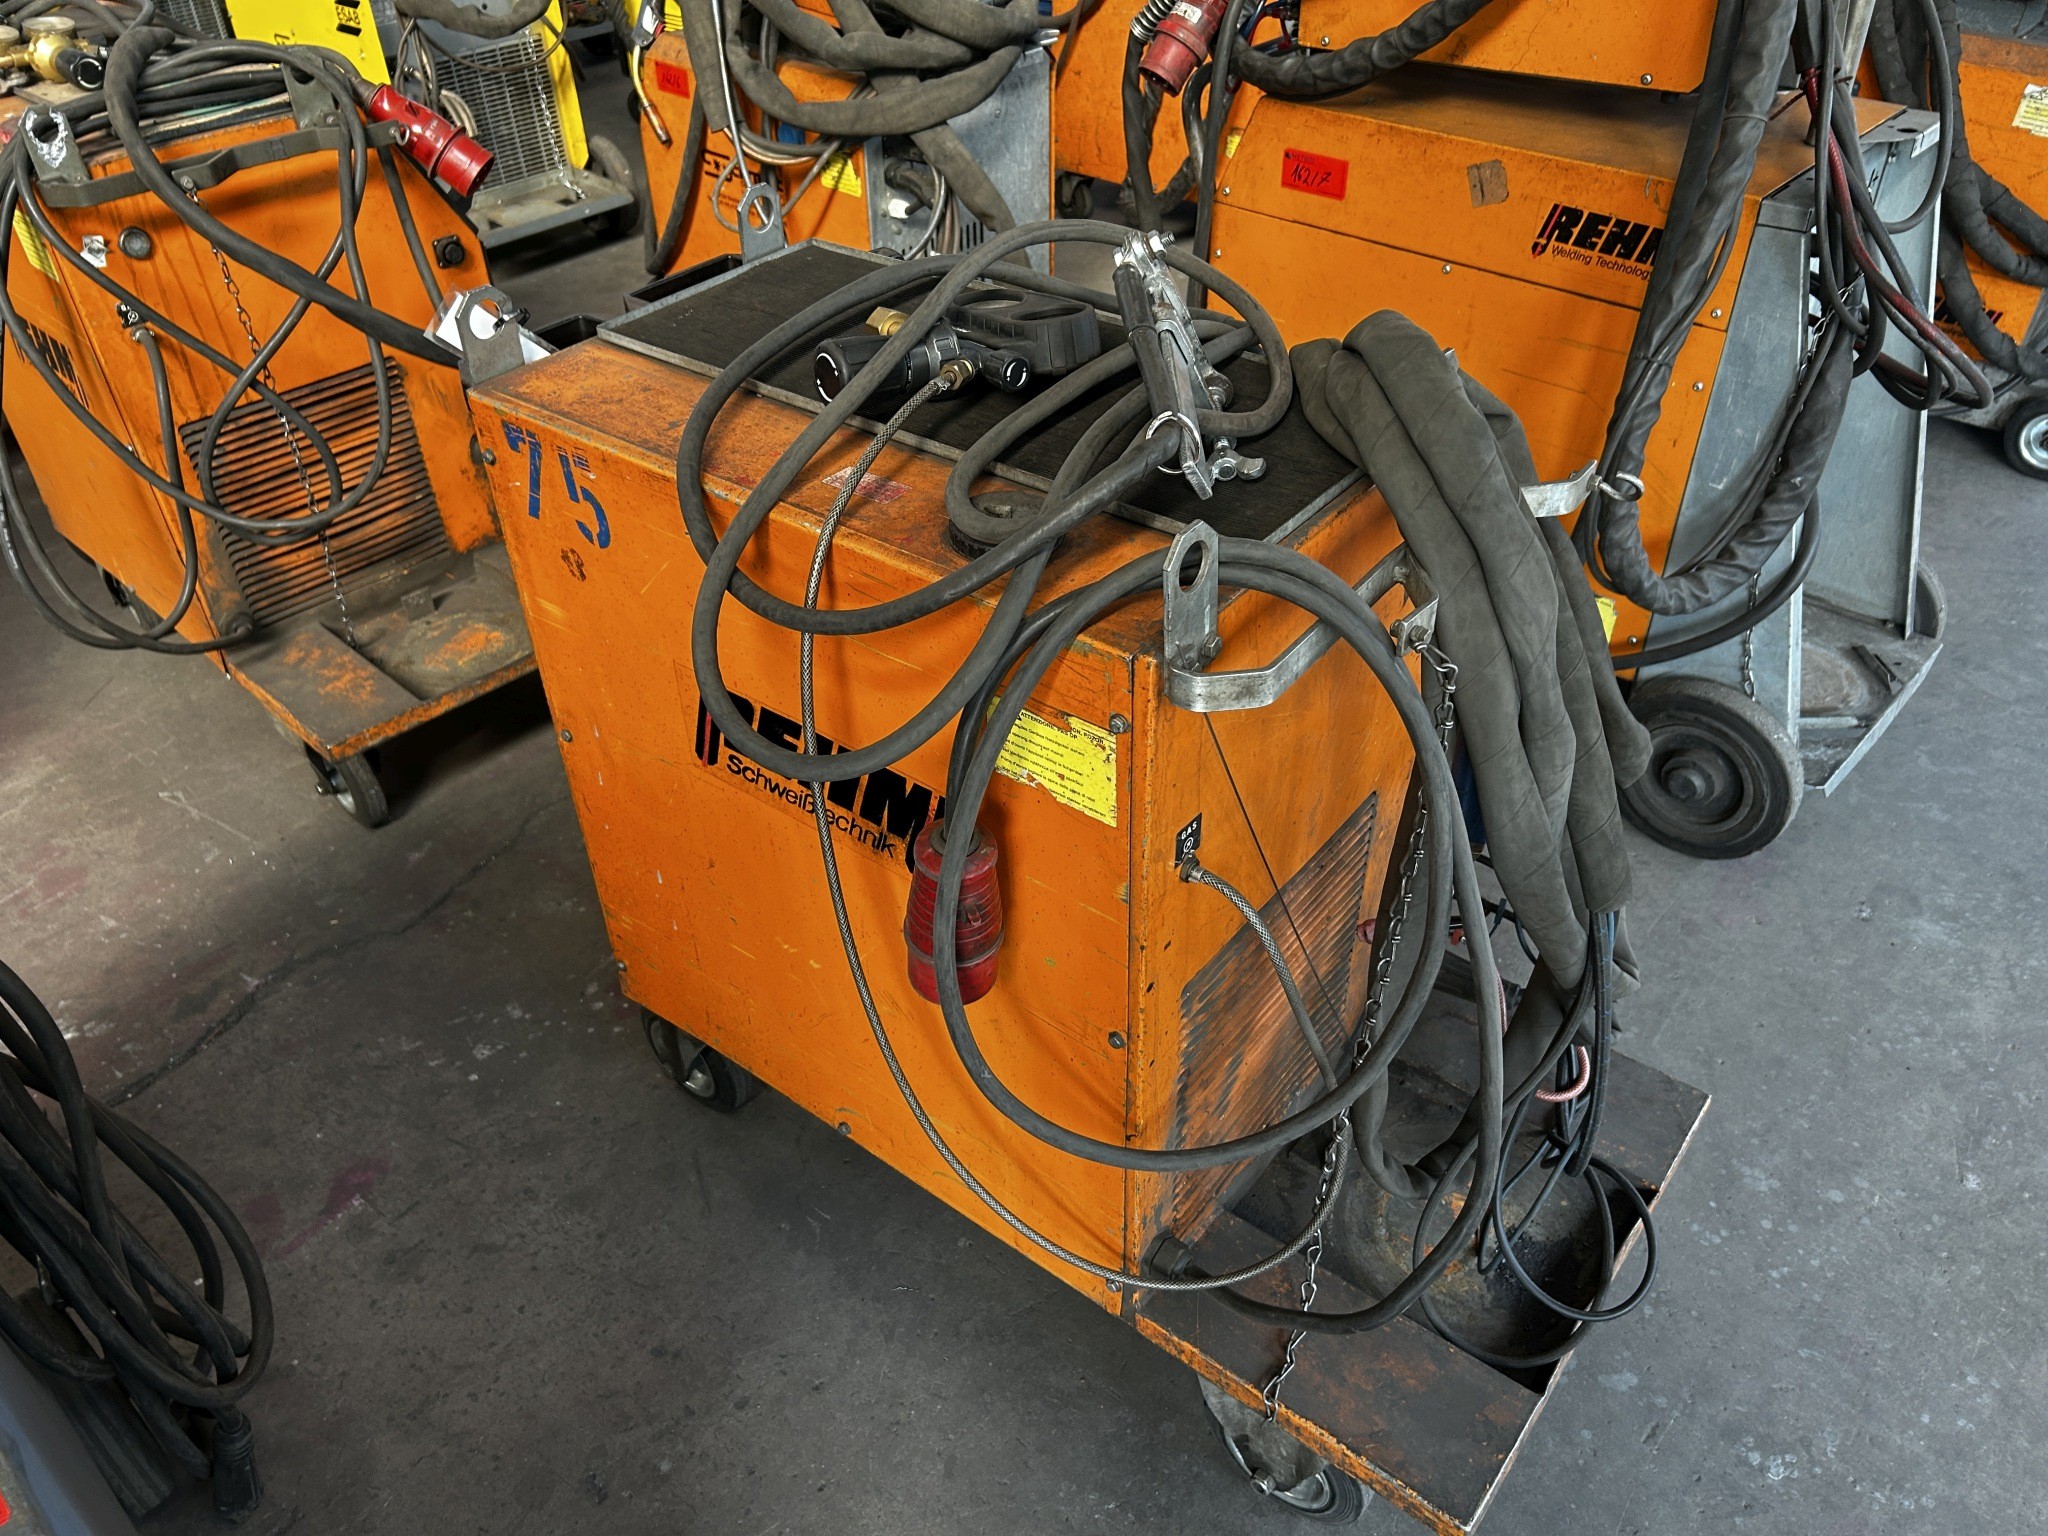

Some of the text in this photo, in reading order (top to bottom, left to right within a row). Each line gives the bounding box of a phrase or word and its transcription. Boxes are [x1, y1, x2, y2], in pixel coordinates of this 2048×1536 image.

[1551, 244, 1653, 281] Welding Technolog
[501, 419, 612, 549] 75
[726, 753, 898, 859] Schweißechnik
[1181, 821, 1198, 840] GAS
